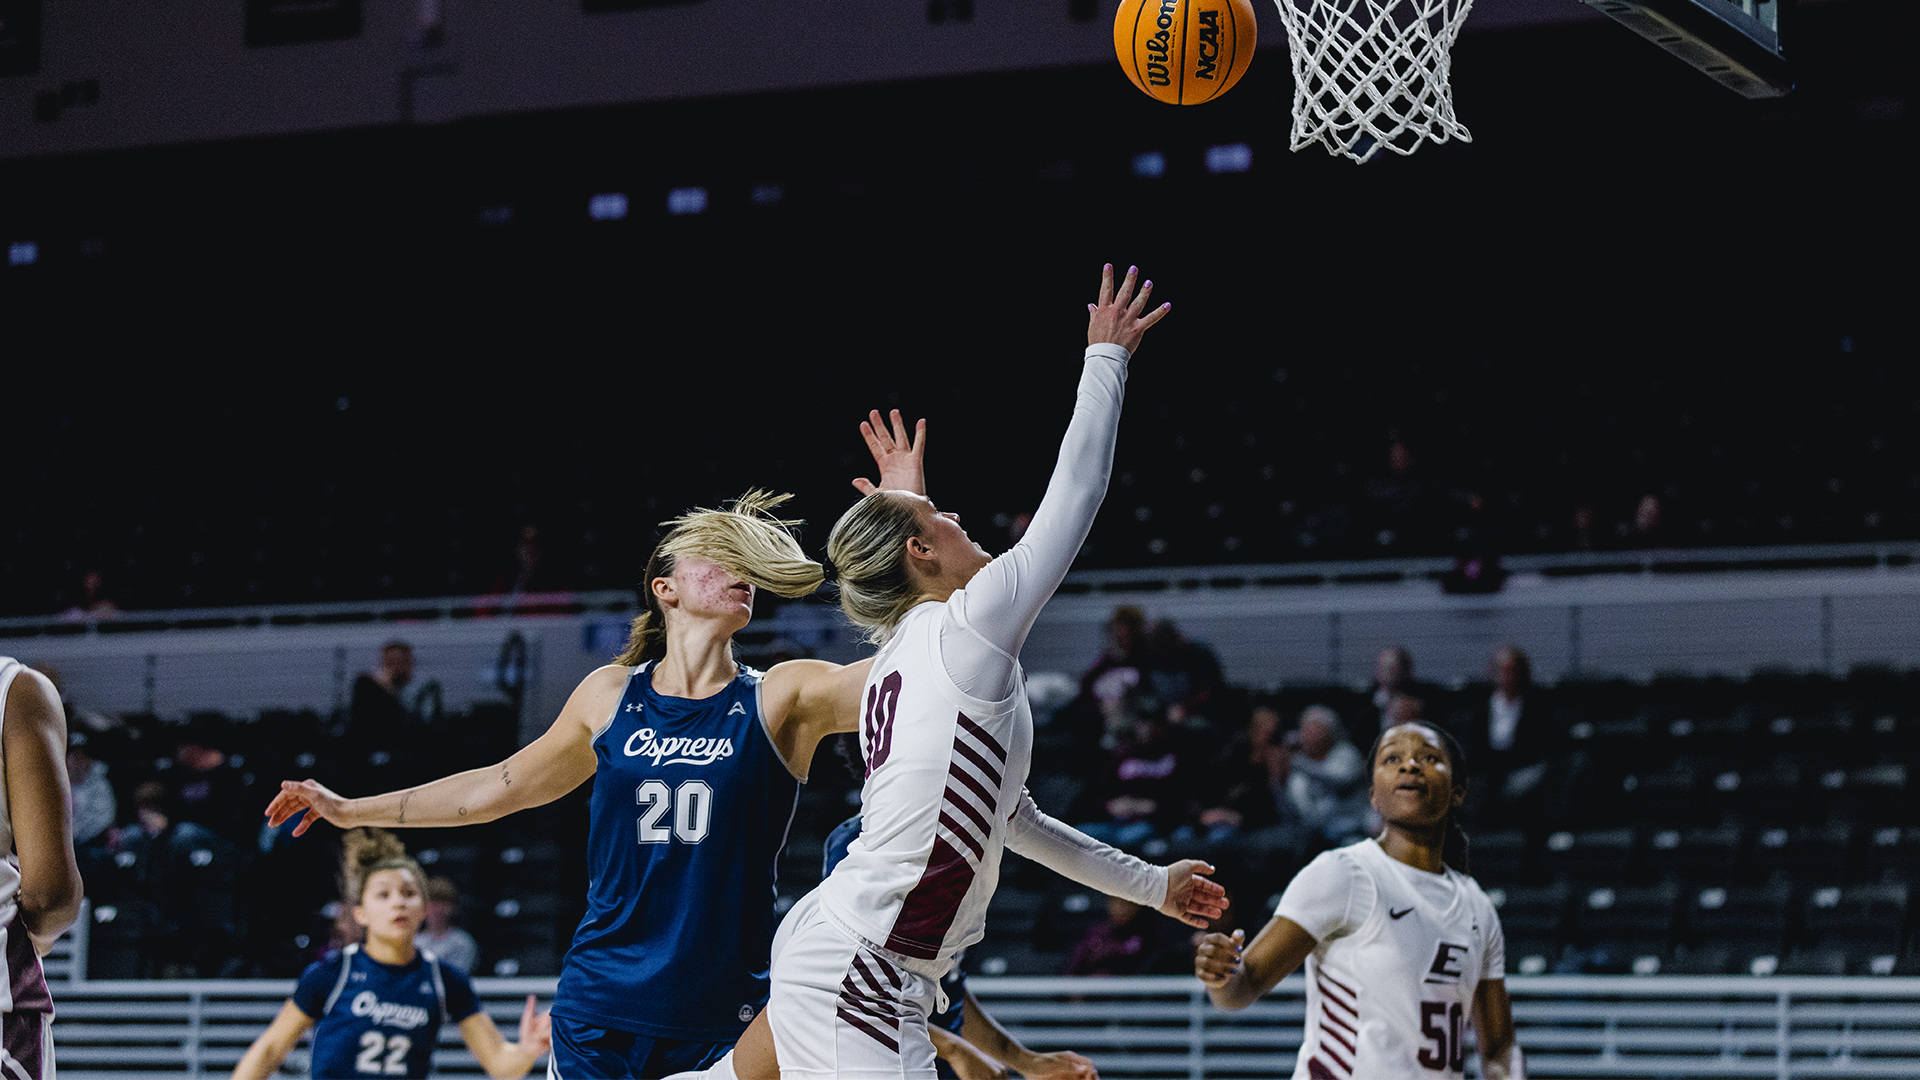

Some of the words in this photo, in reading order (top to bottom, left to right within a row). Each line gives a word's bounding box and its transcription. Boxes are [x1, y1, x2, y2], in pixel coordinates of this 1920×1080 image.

[1146, 0, 1178, 87] Wilson
[1195, 10, 1219, 80] NCAA
[624, 728, 734, 767] Ospreys
[636, 779, 714, 845] 20
[1429, 941, 1468, 979] E
[355, 1030, 412, 1076] 22
[1418, 1001, 1464, 1072] 50
